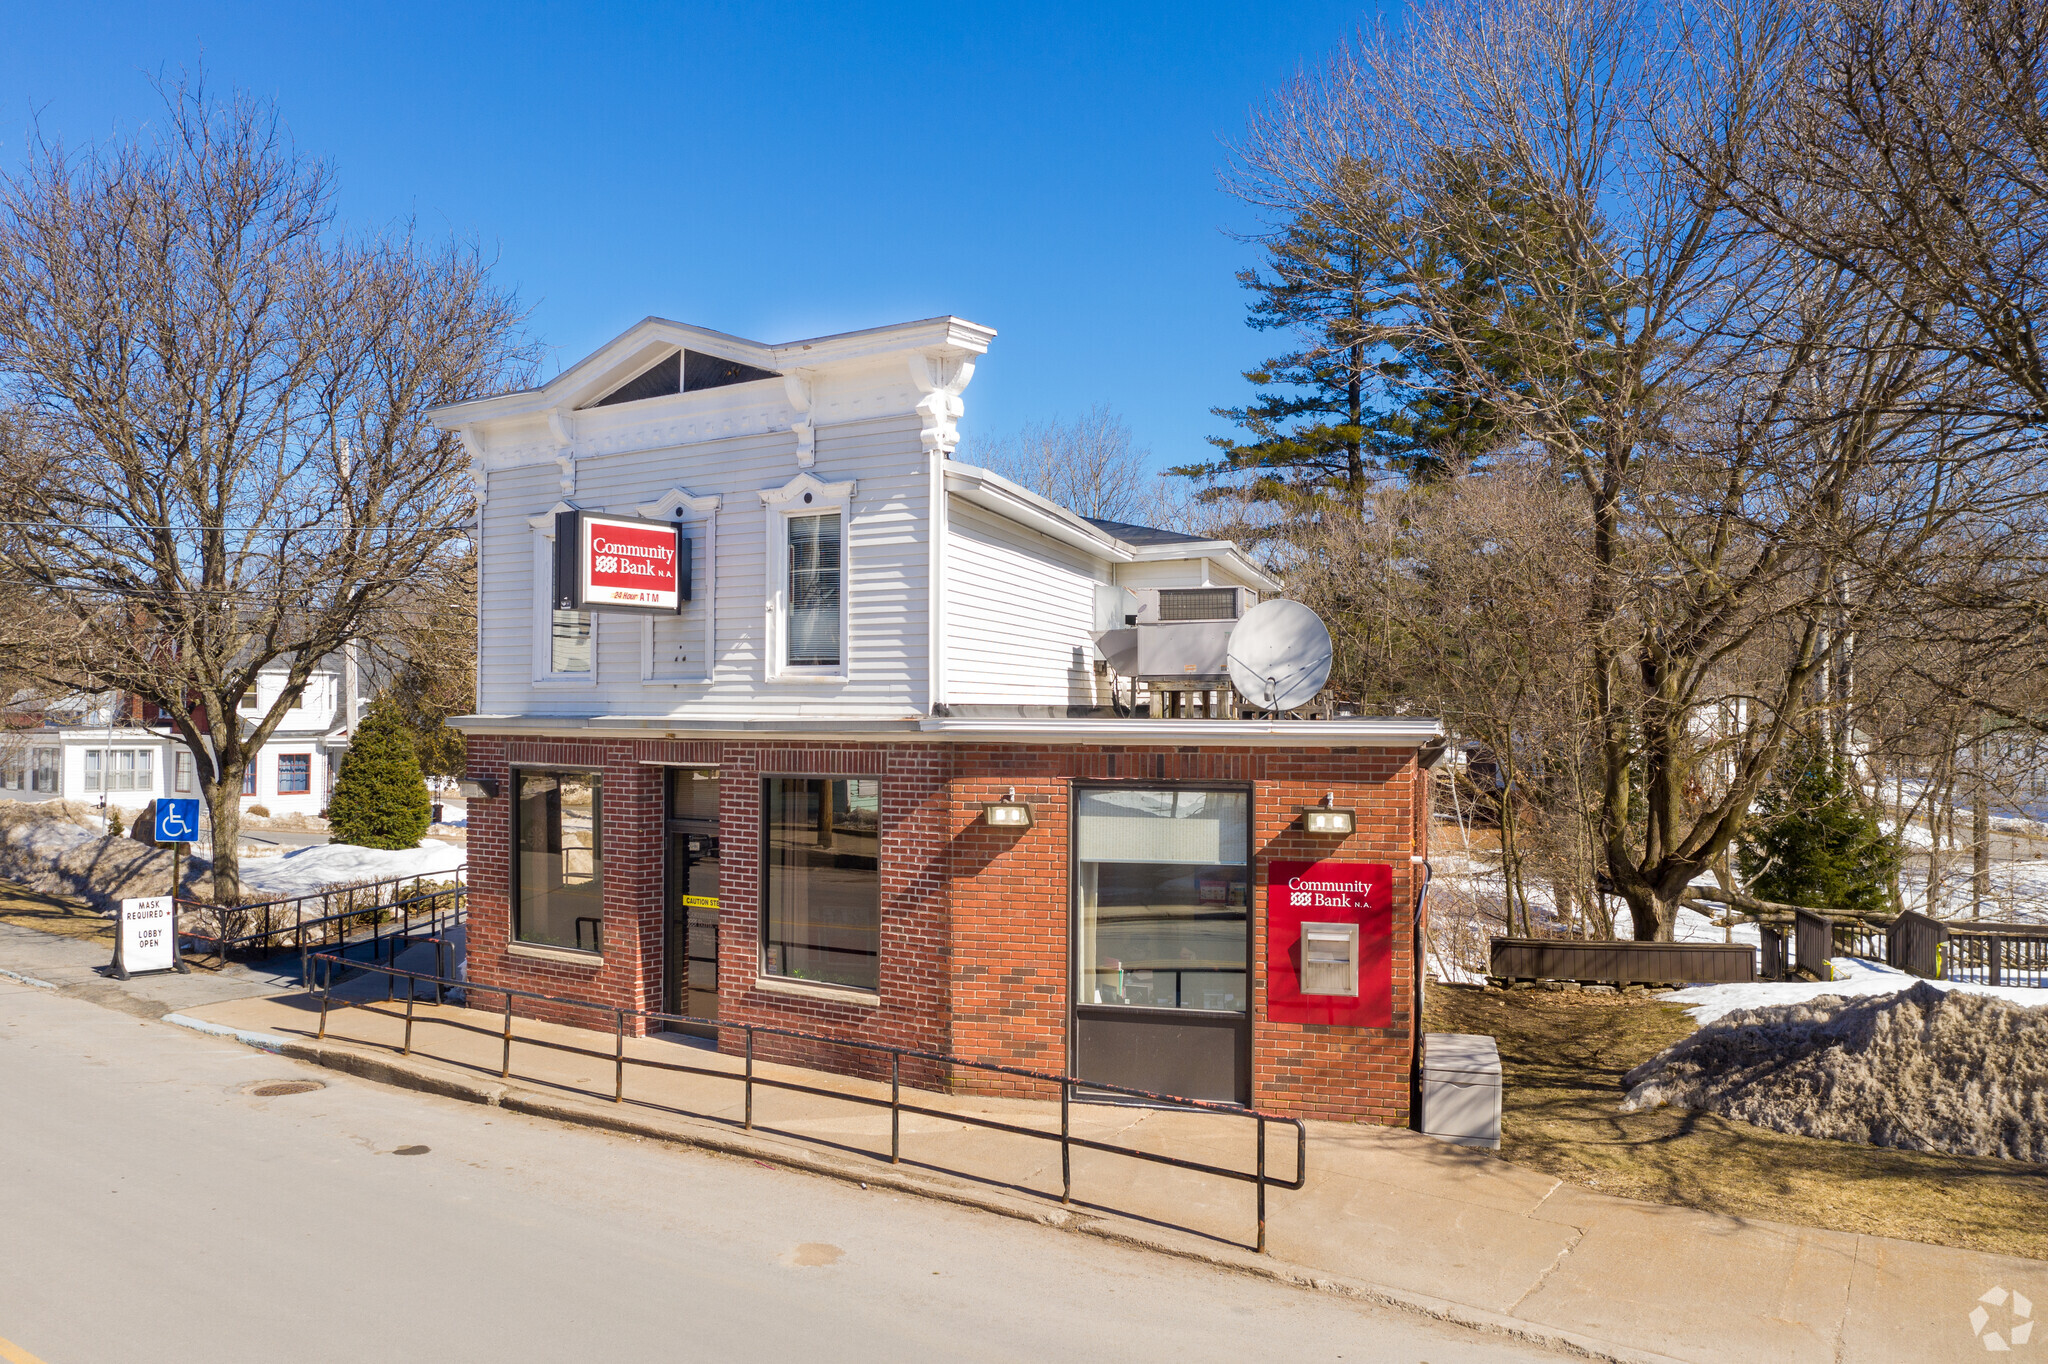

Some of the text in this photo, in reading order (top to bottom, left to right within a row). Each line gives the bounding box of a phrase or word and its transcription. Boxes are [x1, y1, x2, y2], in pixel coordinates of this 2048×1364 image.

[593, 537, 674, 565] Community
[620, 558, 655, 577] Bank
[1288, 877, 1373, 897] Community
[139, 901, 160, 909] MASK
[1315, 893, 1351, 908] Bank
[126, 910, 163, 920] REQUIRED
[138, 929, 162, 938] LOBBY
[139, 939, 159, 948] OPEN
